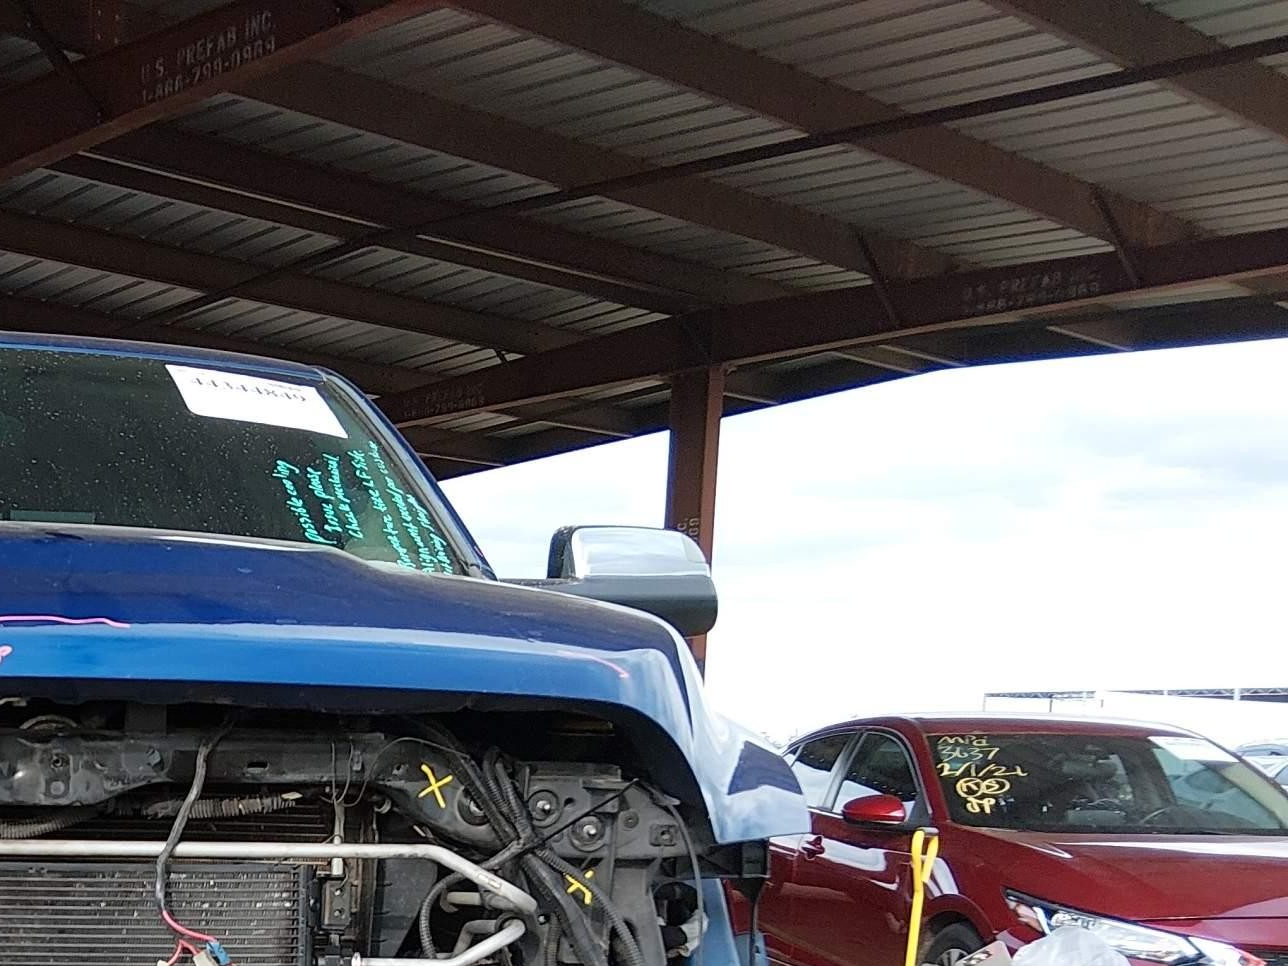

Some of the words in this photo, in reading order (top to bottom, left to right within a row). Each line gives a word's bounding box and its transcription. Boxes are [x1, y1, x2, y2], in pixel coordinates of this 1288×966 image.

[176, 25, 237, 66] PREFAB
[245, 10, 277, 39] INC.
[937, 745, 1000, 761] 3637
